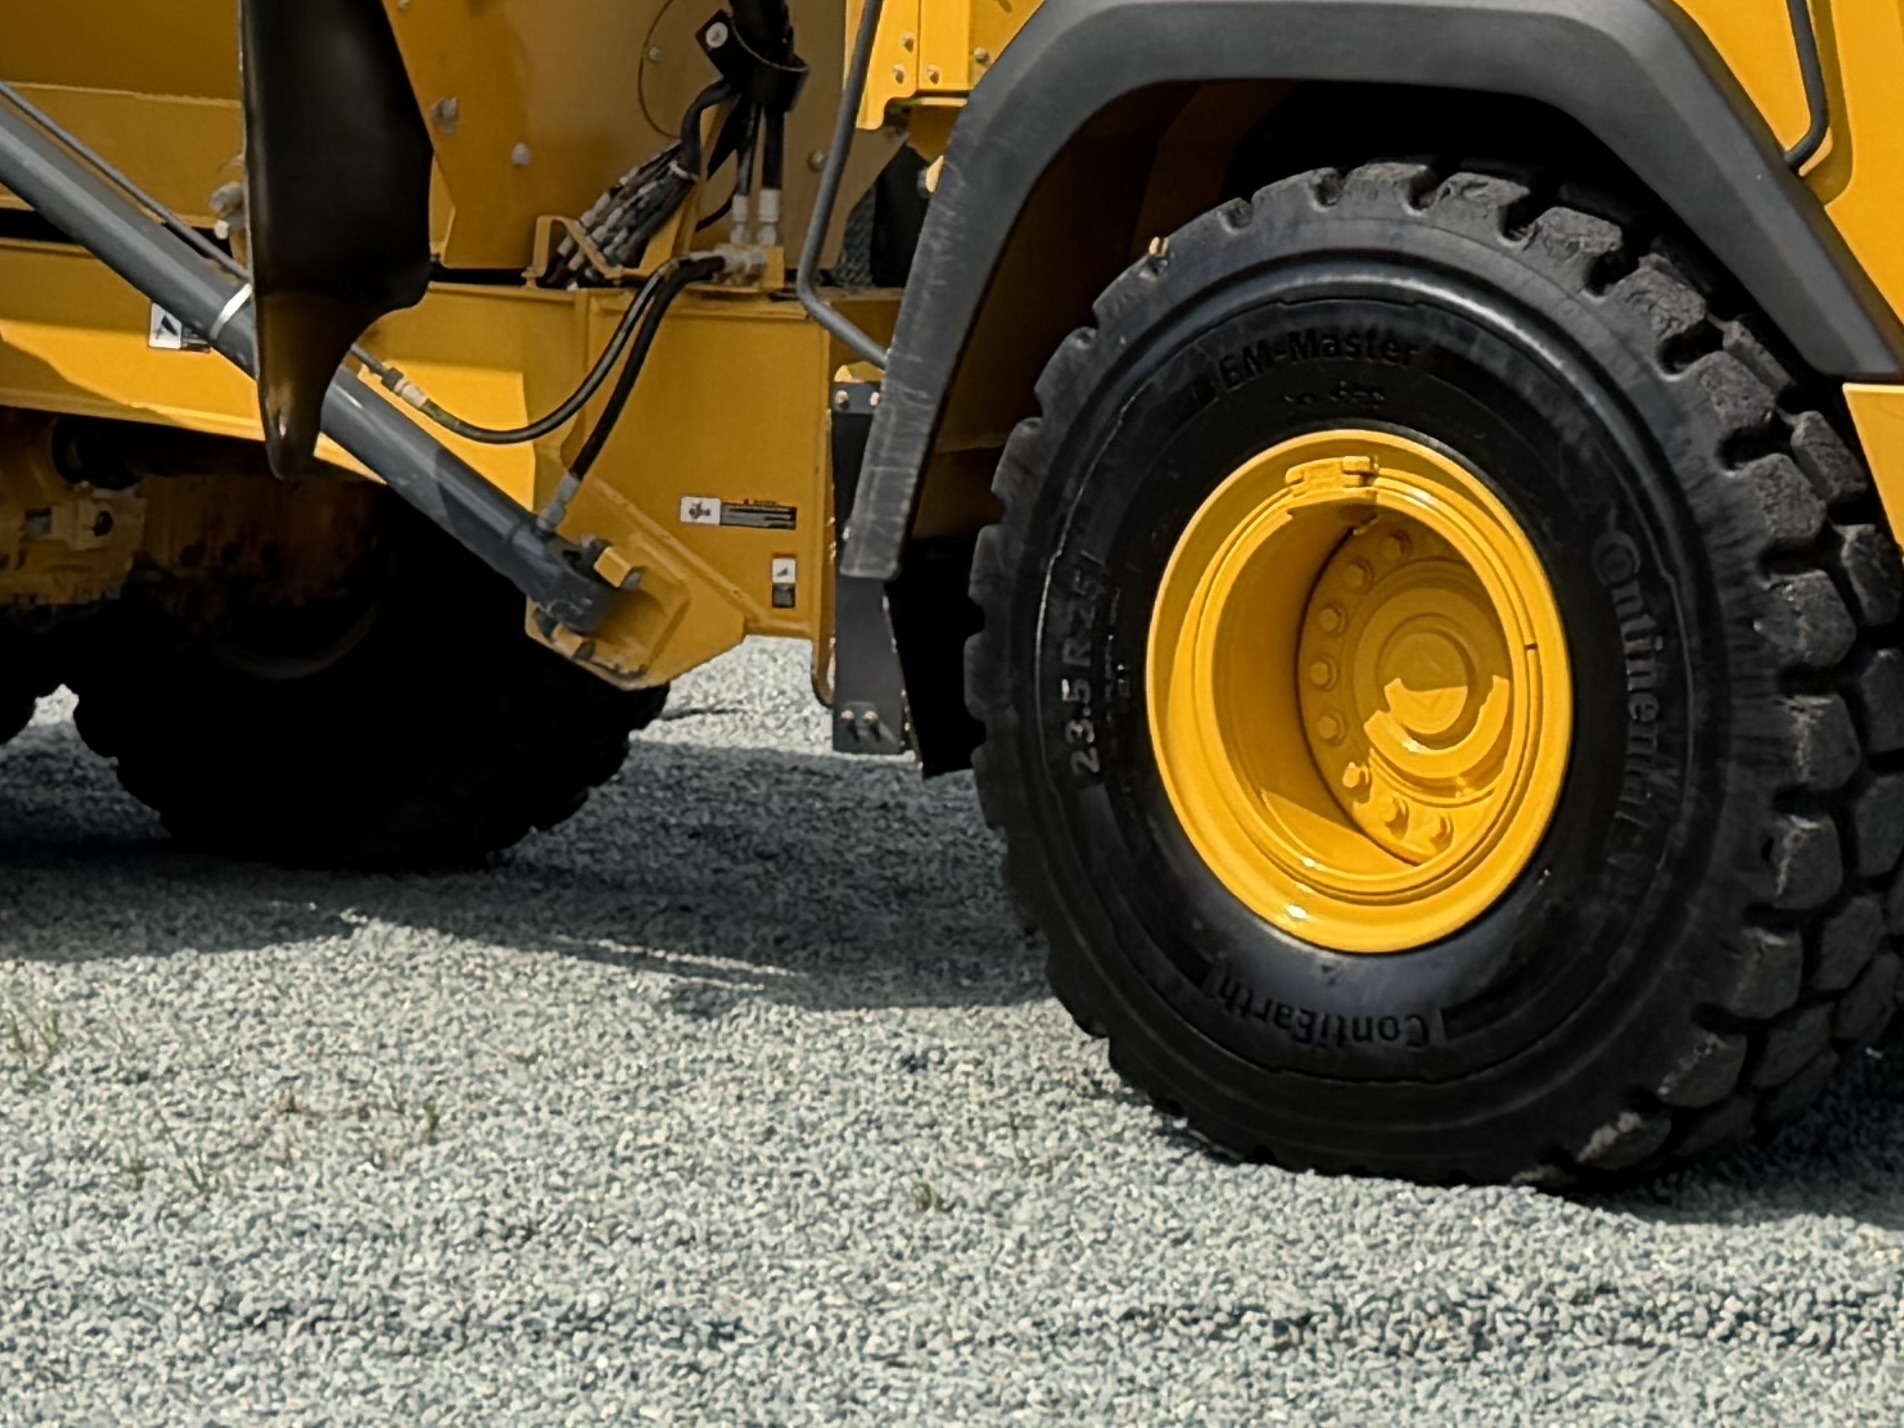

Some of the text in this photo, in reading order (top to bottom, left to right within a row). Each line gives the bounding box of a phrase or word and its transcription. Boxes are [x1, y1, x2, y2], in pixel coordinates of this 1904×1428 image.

[1217, 326, 1422, 391] EM-Master
[1061, 636, 1093, 668] R
[1061, 678, 1101, 777] 23.5
[1211, 972, 1430, 1049] ContiEarth
